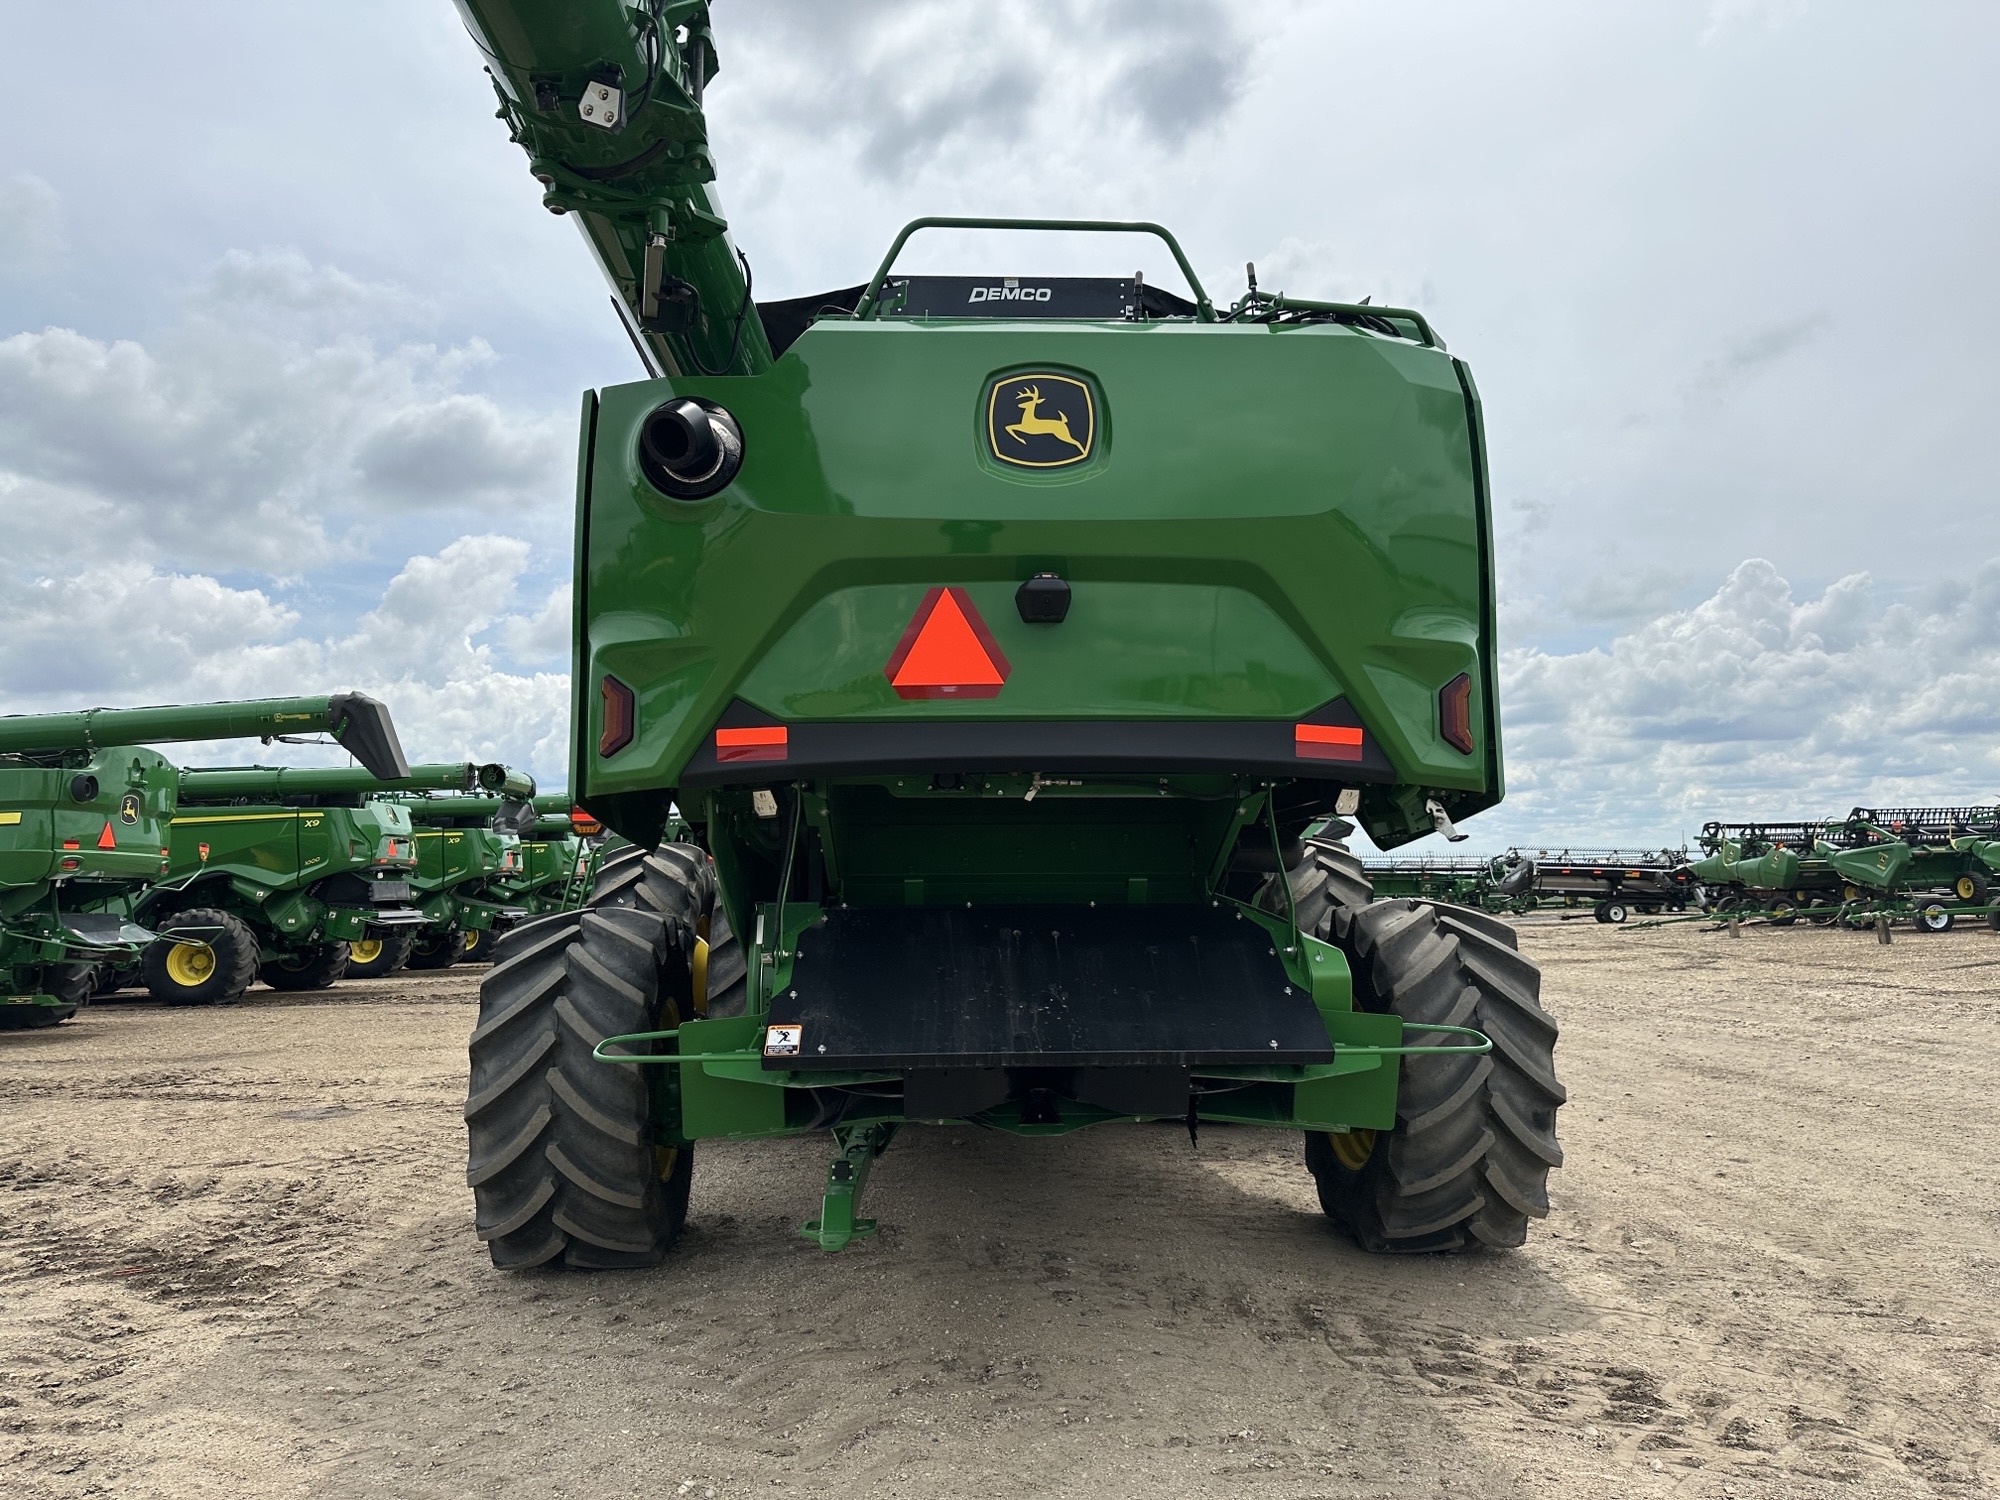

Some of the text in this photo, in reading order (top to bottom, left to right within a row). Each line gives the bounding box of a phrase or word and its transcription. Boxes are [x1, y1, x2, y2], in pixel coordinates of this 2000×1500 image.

[968, 287, 1051, 303] DEMCO
[304, 819, 320, 828] X9
[304, 856, 321, 866] 1000
